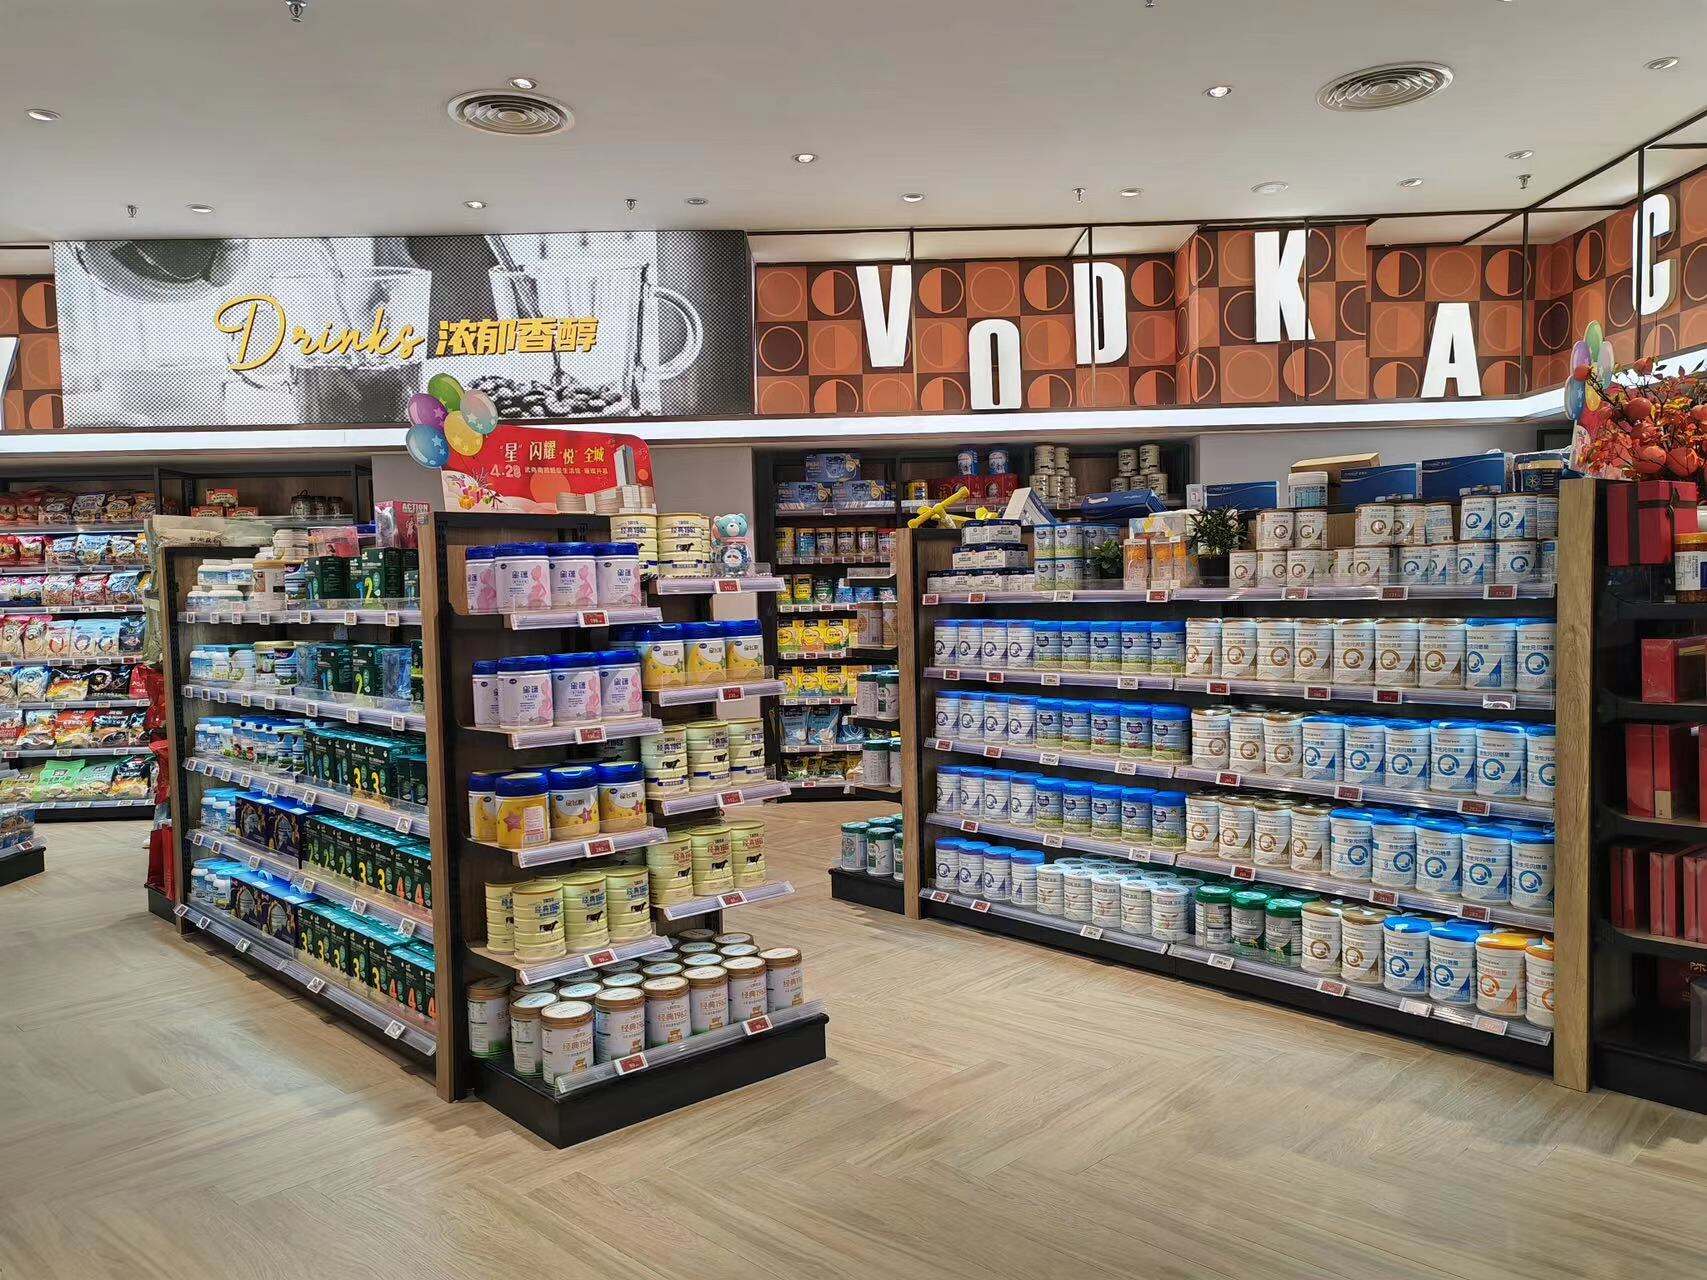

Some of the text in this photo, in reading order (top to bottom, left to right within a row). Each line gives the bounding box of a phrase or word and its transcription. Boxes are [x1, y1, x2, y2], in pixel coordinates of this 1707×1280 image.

[214, 294, 425, 370] Drinks
[435, 316, 599, 356] 浓郁香醇
[530, 440, 556, 461] 闪耀
